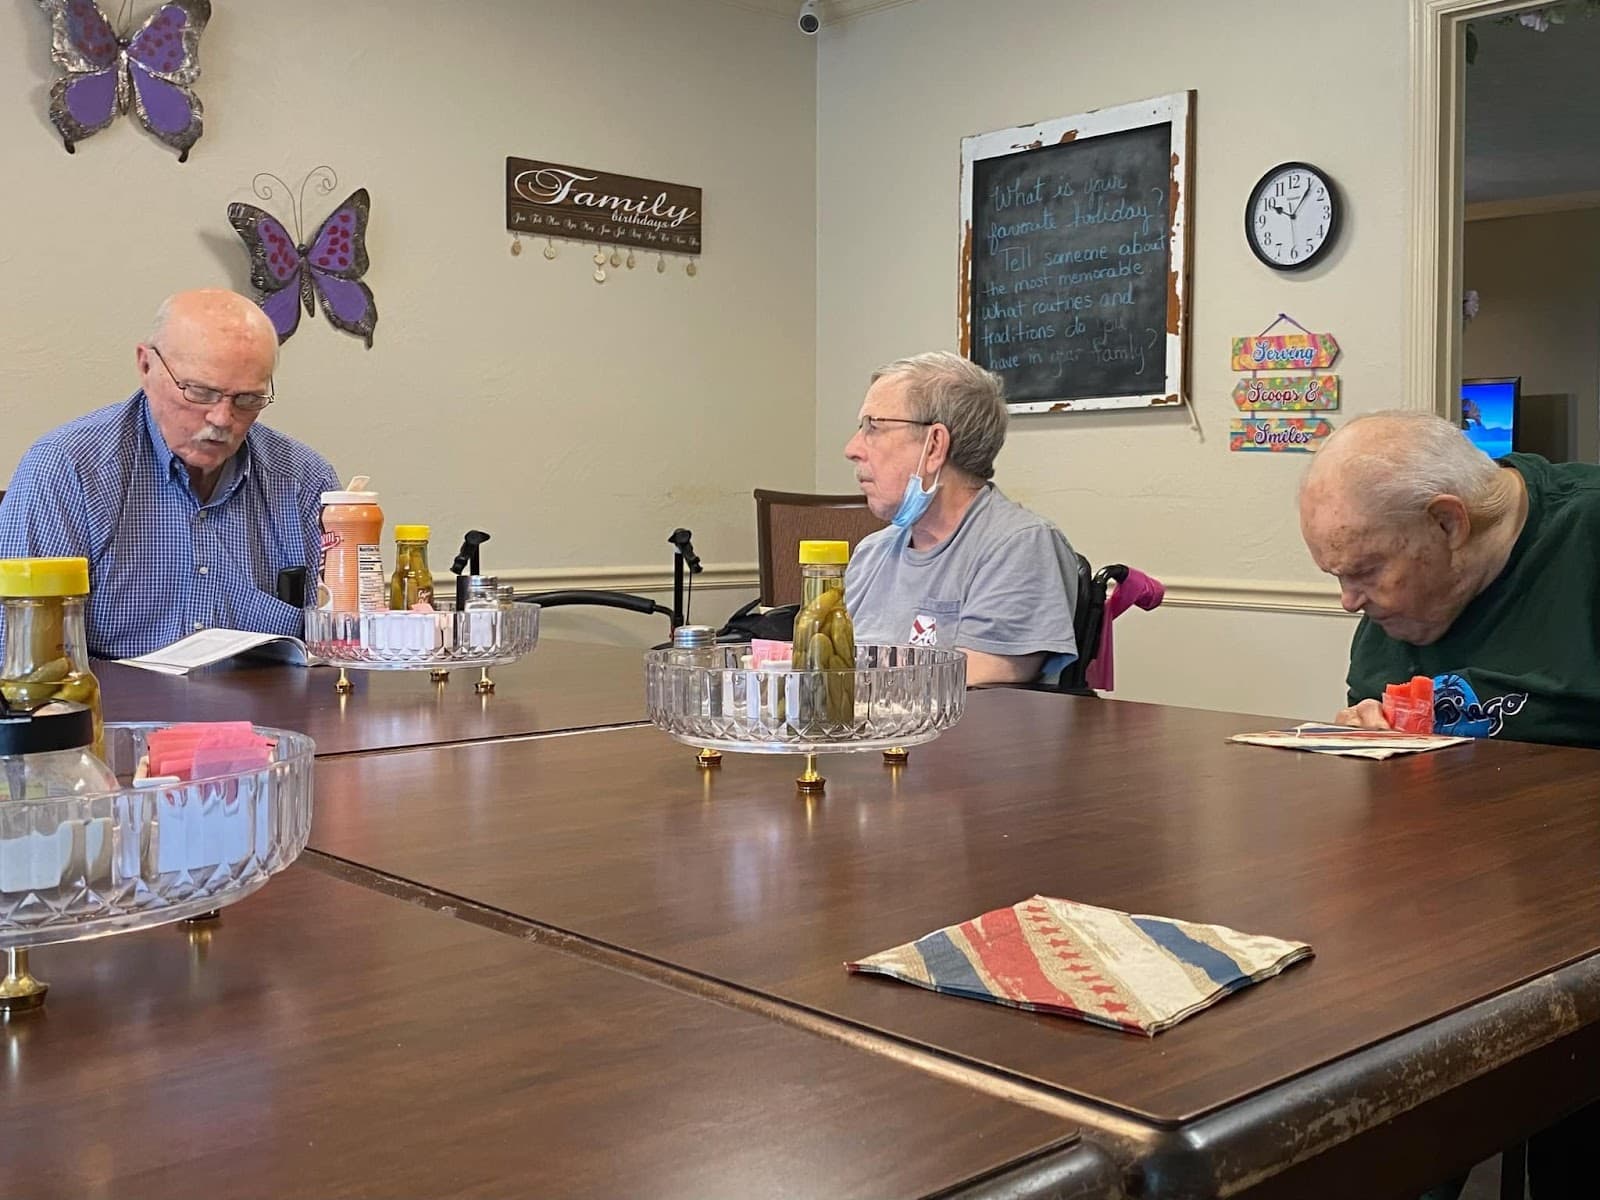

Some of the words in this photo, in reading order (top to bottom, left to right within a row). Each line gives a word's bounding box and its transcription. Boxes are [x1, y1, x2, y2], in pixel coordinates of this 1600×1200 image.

[514, 168, 697, 228] Family
[989, 176, 1046, 212] What
[1052, 175, 1074, 198] is
[611, 209, 670, 232] birthdays
[1000, 245, 1032, 272] Tell
[1043, 246, 1108, 266] someone
[1119, 228, 1166, 255] about
[979, 280, 1007, 296] the
[1015, 274, 1050, 294] most
[1059, 262, 1144, 286] memorable
[982, 300, 1026, 321] what
[1100, 282, 1135, 305] and
[981, 322, 1055, 346] traditions
[1065, 316, 1086, 337] do
[988, 345, 1020, 370] have
[1028, 350, 1043, 365] in
[1253, 340, 1315, 365] Serving
[1248, 381, 1299, 404] Scoops
[1305, 381, 1319, 402] &
[1255, 423, 1311, 445] Smiles
